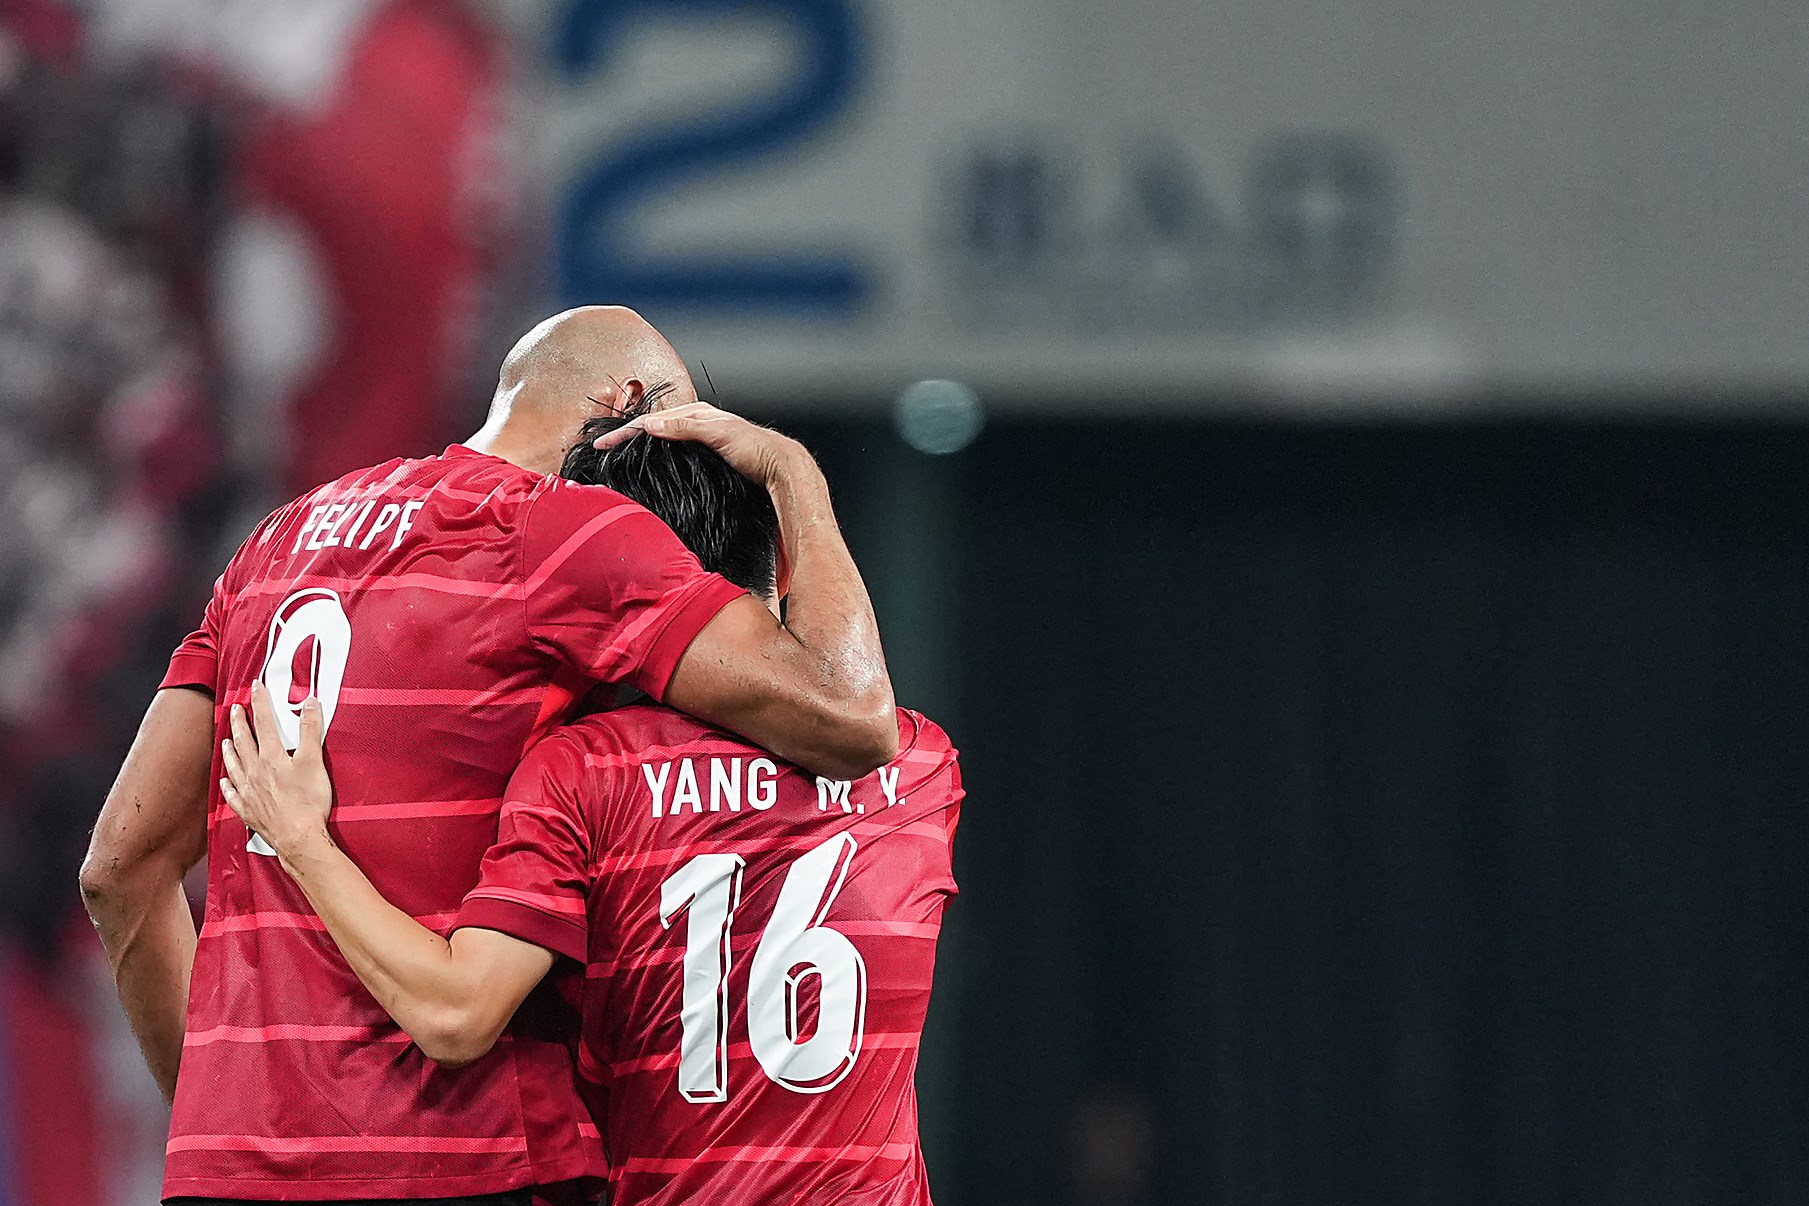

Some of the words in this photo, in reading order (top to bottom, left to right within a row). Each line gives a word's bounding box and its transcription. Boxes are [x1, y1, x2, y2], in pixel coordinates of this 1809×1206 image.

[558, 0, 874, 315] 2
[291, 499, 425, 555] FELIPE
[642, 757, 778, 818] YANG
[660, 831, 867, 1104] 16
